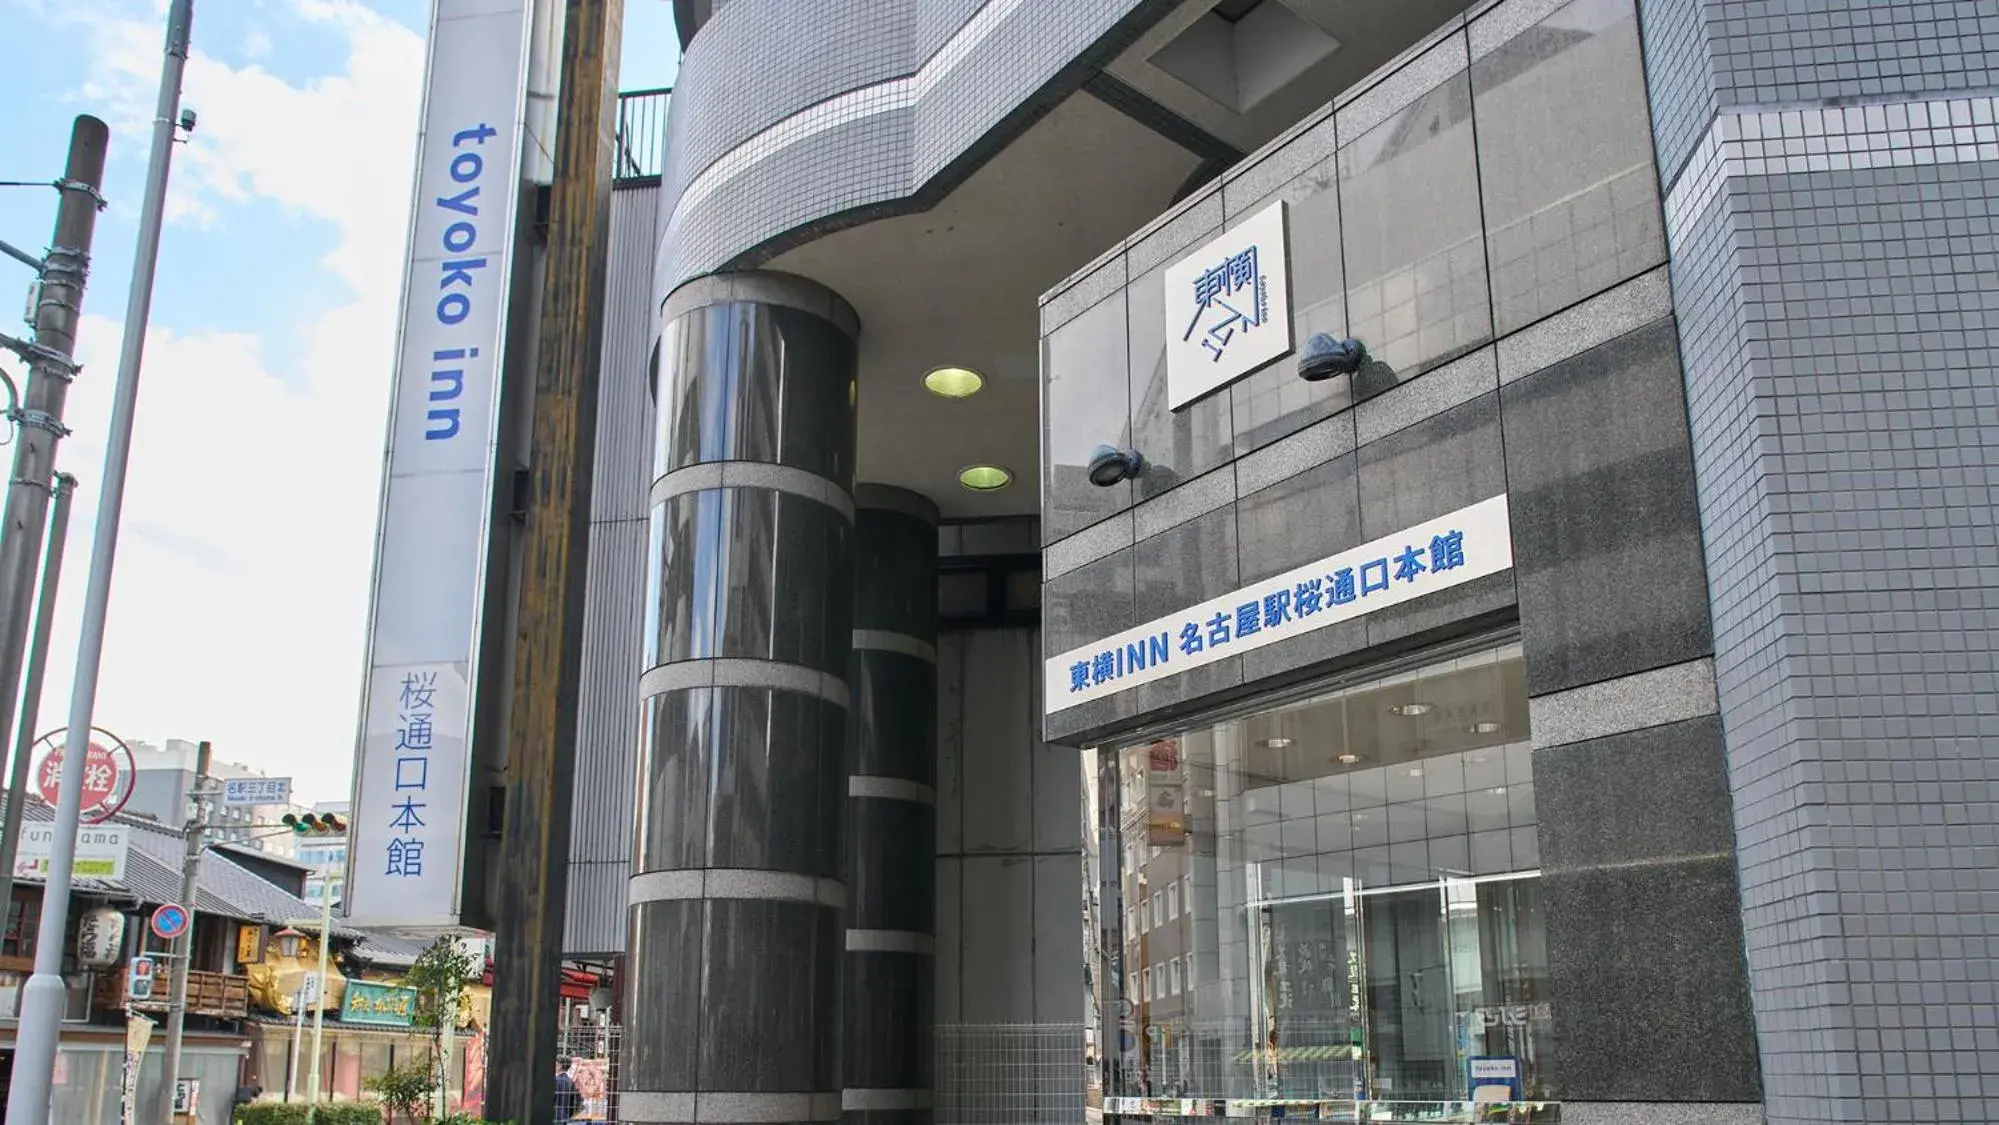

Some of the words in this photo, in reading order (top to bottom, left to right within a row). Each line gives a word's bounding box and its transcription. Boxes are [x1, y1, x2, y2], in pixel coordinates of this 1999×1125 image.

[437, 123, 498, 325] toyoko
[425, 347, 479, 441] inn
[1068, 631, 1170, 693] 東横INN
[1179, 529, 1466, 656] 名古屋駅桜通口本館
[21, 827, 119, 845] funama
[43, 762, 112, 792] 消栓
[384, 671, 438, 878] 桜通口本館
